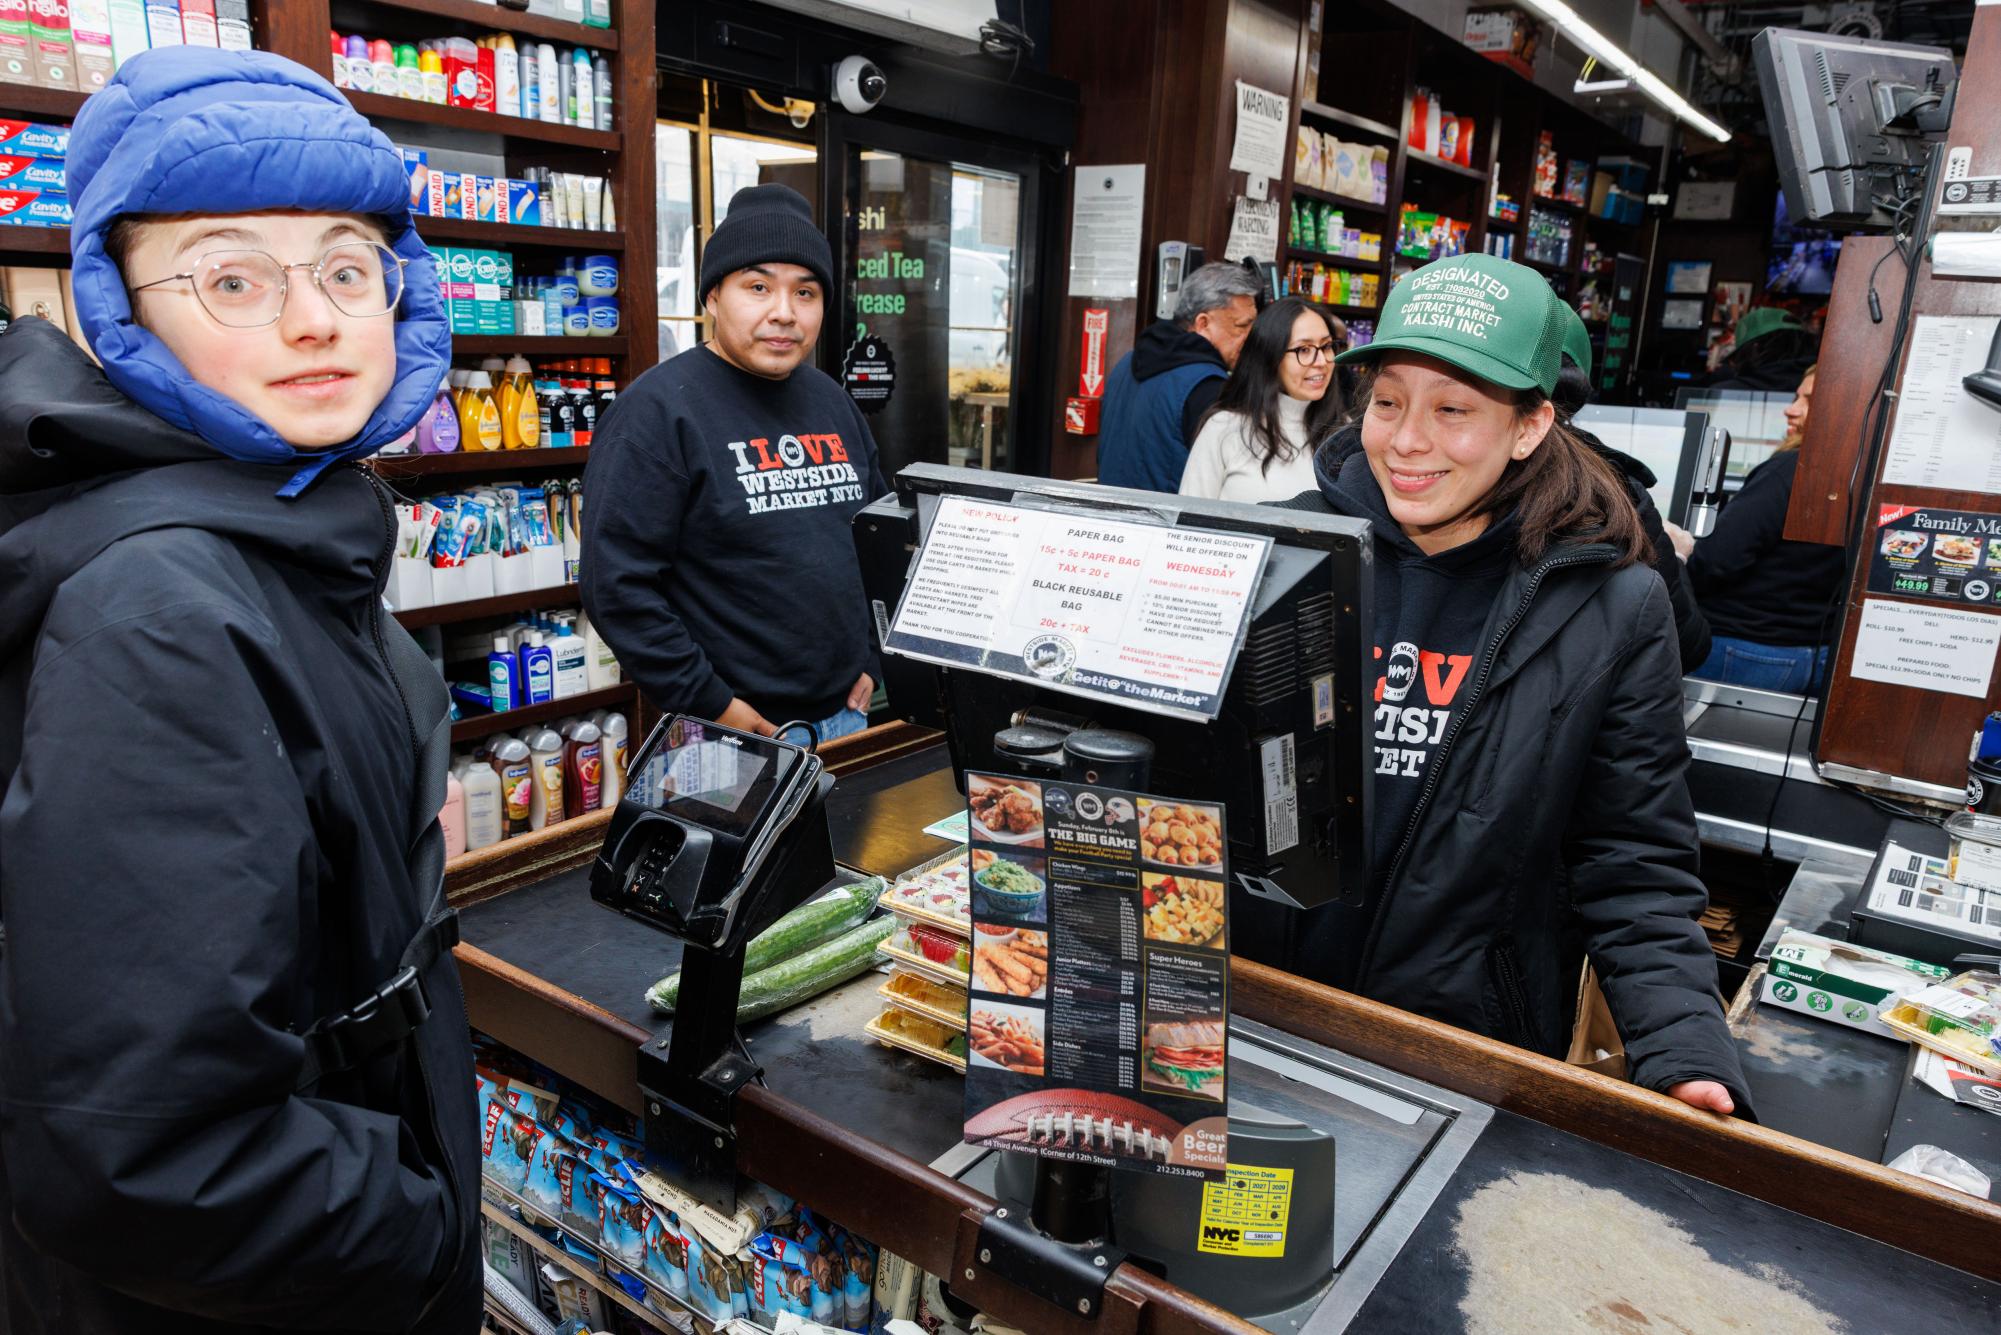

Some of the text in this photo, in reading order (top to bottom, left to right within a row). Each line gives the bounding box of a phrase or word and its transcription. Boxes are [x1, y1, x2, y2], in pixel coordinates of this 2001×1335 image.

[1242, 88, 1284, 122] WARNING
[22, 131, 56, 144] Cavity
[26, 166, 59, 179] Cavity
[30, 201, 65, 214] Cavity
[891, 252, 924, 278] Tea
[1411, 267, 1509, 301] DESIGNATED
[1425, 283, 1443, 291] EST.
[1413, 293, 1432, 302] UNITED
[1432, 293, 1456, 302] STATES
[1466, 299, 1495, 312] AMERICA
[1401, 302, 1502, 327] CONTRACT MARKET
[1087, 317, 1104, 330] FIRE
[1403, 314, 1487, 339] KALSHI INC.
[728, 441, 756, 475] I
[747, 462, 859, 495] WESTSIDE
[746, 484, 863, 515] MARKET NYC
[1879, 508, 1904, 524] New!
[1911, 512, 1972, 534] Family
[1067, 528, 1125, 543] PAPER BAG
[1167, 532, 1256, 550] THE SENIOR DISCOUNT
[1166, 544, 1184, 552] WILL
[1199, 547, 1234, 558] OFFERED
[1081, 551, 1141, 567] PAPER BAG
[1057, 563, 1101, 576] TAX 20
[1166, 561, 1237, 579] WEDNESDAY
[1149, 578, 1168, 587] FROM
[1894, 580, 1929, 592] $49.99
[1032, 579, 1124, 602] BLACK REUSABLE
[909, 600, 975, 617] AVAILABLE FRONT
[1060, 600, 1083, 611] BAG
[1185, 598, 1218, 608] PURCHASE
[1149, 610, 1166, 618] HAVE
[1193, 617, 1223, 626] REQUEST
[1165, 604, 1222, 618] SENIOR DISCOUNT
[902, 620, 919, 628] THANK
[1070, 623, 1090, 634] TAX
[1146, 618, 1172, 628] CANNOT
[1182, 624, 1216, 634] COMBINED
[1158, 630, 1179, 638] OTHER
[1898, 637, 1914, 645] FREE
[1971, 637, 1994, 645] $12.99
[1122, 646, 1155, 657] EXCLUDES
[1897, 656, 1951, 669] PREPARED FOOD:
[1865, 662, 1889, 671] SPECIAL
[1962, 676, 1982, 684] CHIPS
[1057, 820, 1108, 834] Sunday, February
[1047, 828, 1137, 850] THE BIG GAME
[1052, 861, 1072, 869] Chicken
[1053, 882, 1081, 891] Appetizers
[1071, 958, 1091, 966] Platters
[1149, 952, 1203, 967] Super Heroes
[1775, 962, 1813, 982] Emerald
[1052, 1039, 1064, 1047] Side
[1196, 1129, 1226, 1142] Great
[1184, 1134, 1226, 1154] Beer
[992, 1140, 1117, 1167] Third Avenue (Corner of 12th Street)
[1184, 1150, 1225, 1164] Specials
[1156, 1165, 1205, 1178] 212.253.8400
[657, 1183, 678, 1200] ALMOND
[703, 1209, 729, 1229] MACADAMIA
[1203, 1225, 1241, 1242] NYC
[1202, 1238, 1223, 1246] Consumer
[578, 1287, 591, 1318] READY
